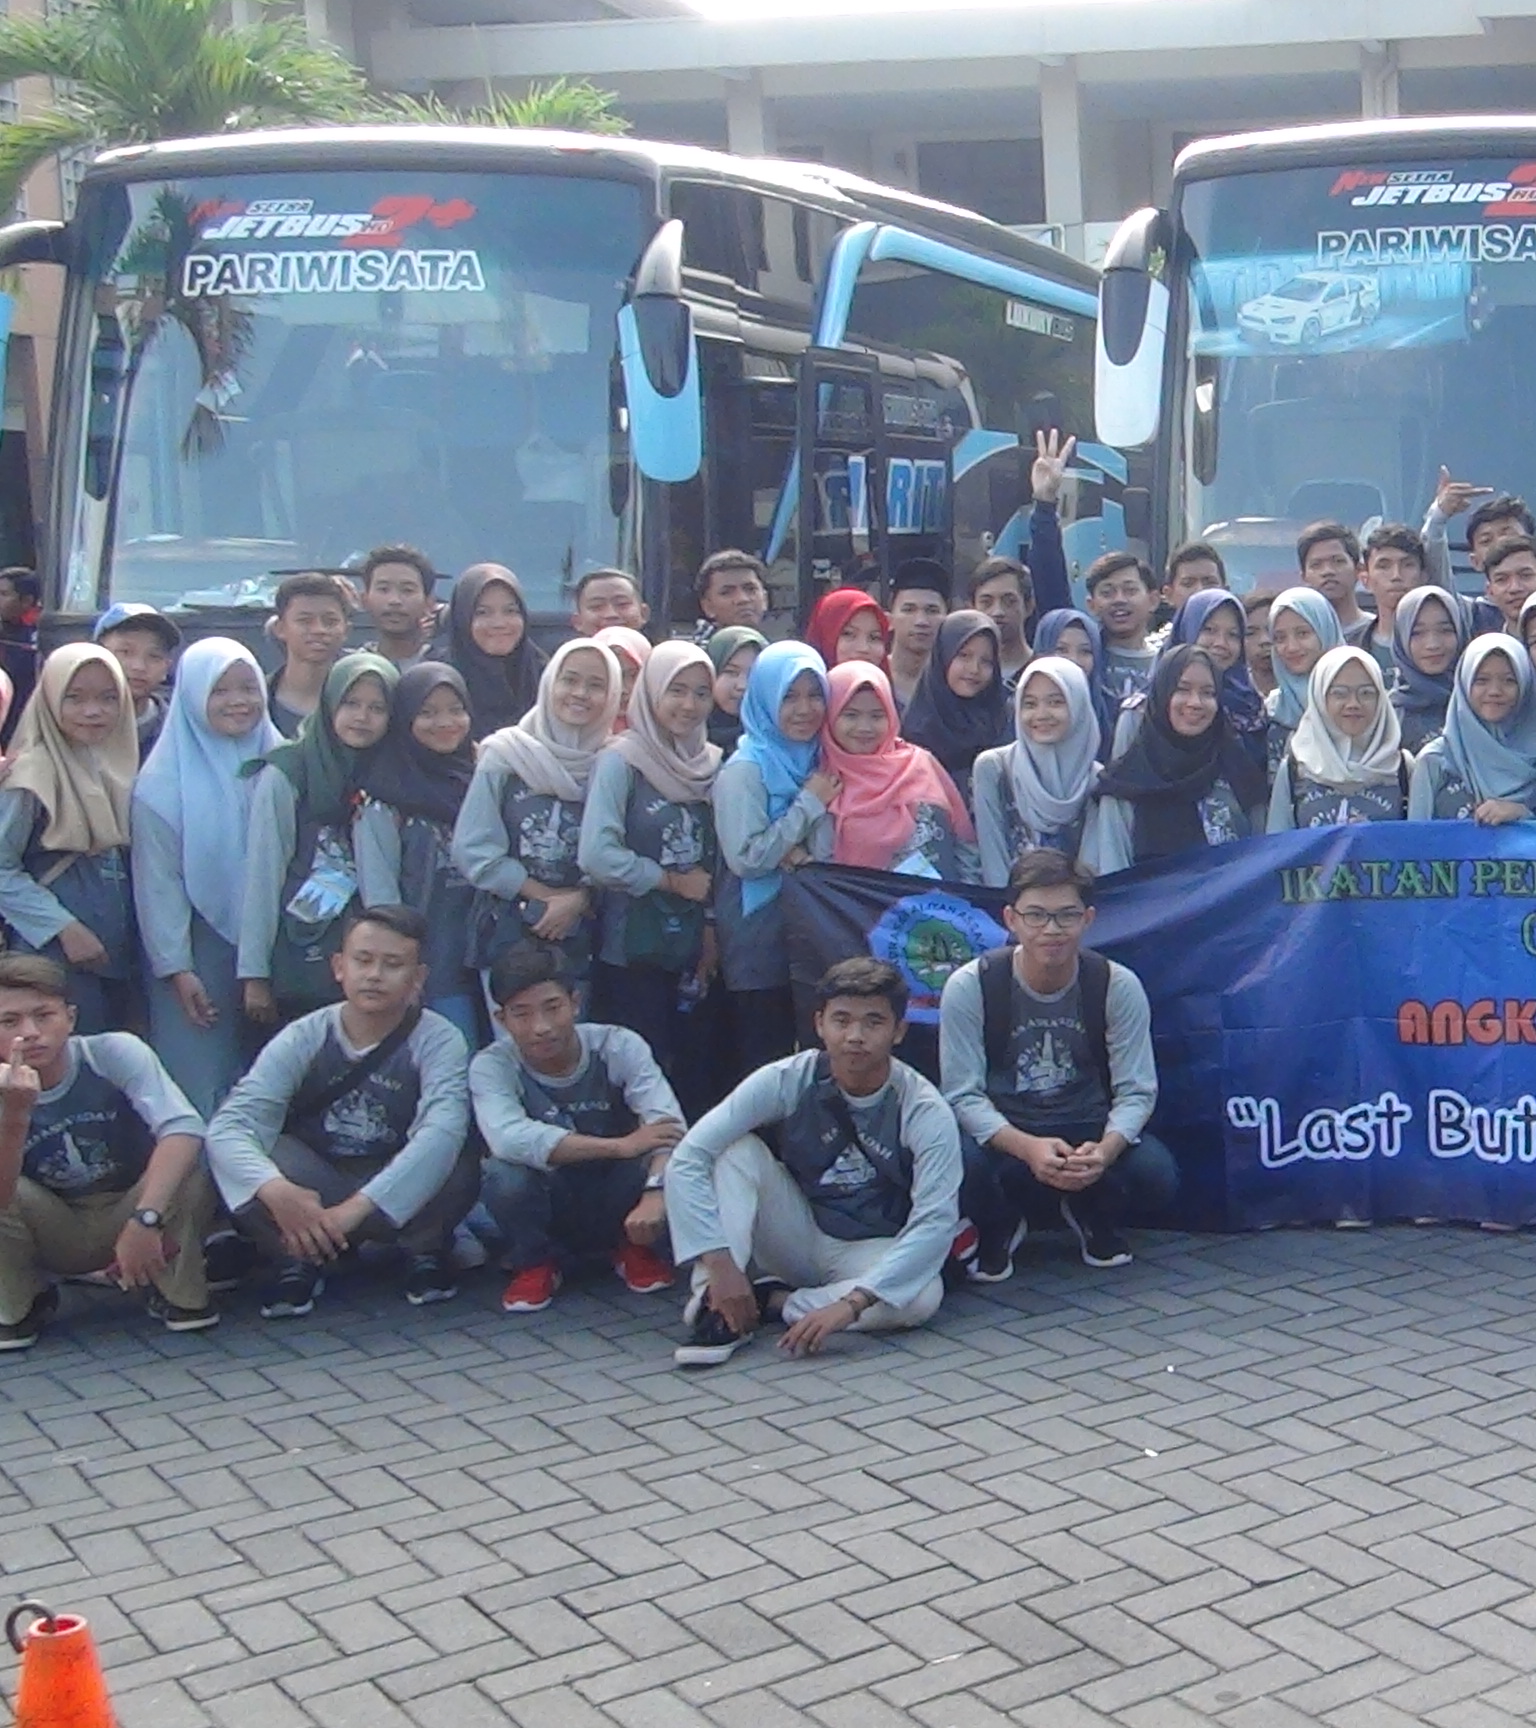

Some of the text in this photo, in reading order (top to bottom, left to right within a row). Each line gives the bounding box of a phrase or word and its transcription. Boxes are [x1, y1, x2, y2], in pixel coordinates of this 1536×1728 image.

[1352, 183, 1513, 207] JETBUS
[202, 213, 373, 239] JETBUS
[182, 250, 486, 297] PARIWISATA
[1280, 859, 1459, 906] IKATAN
[1228, 1091, 1412, 1169] "Last
